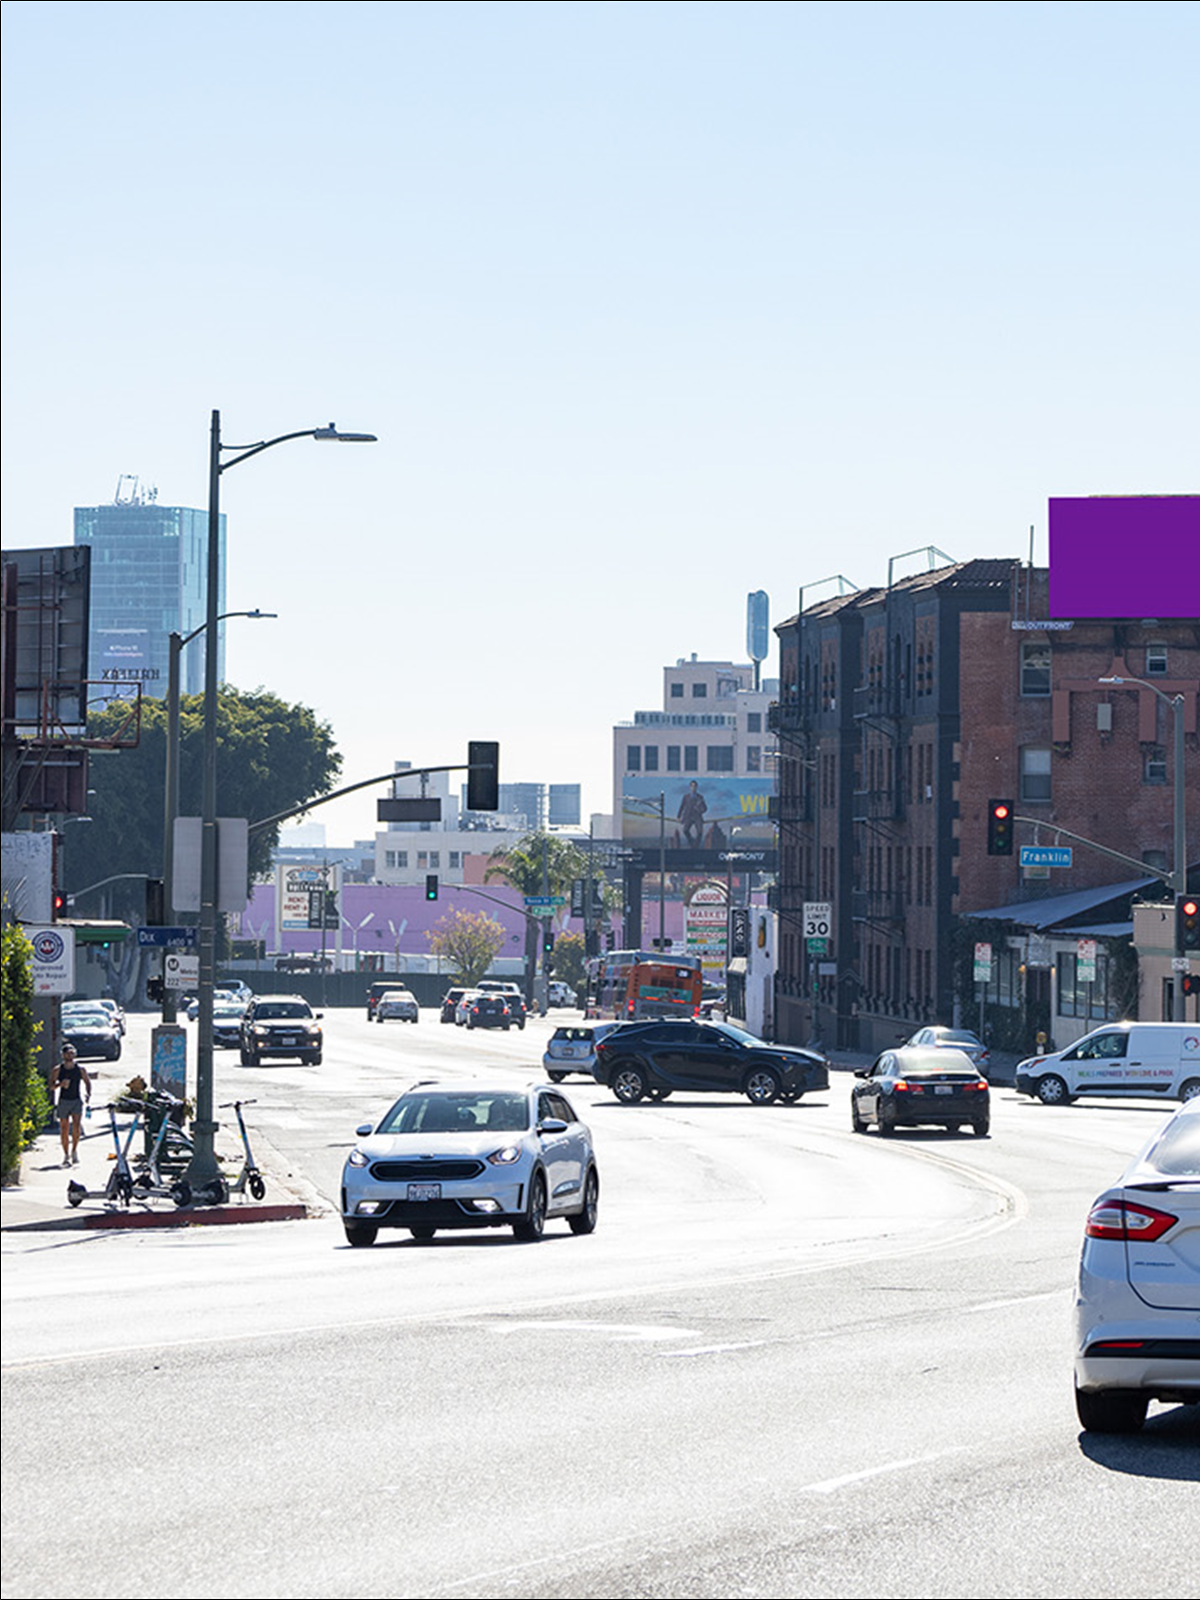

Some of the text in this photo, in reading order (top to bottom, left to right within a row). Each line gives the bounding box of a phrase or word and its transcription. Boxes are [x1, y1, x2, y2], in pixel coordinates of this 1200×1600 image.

[1023, 851, 1069, 862] Franklin
[696, 893, 721, 901] LIQUOR
[806, 921, 828, 935] 30
